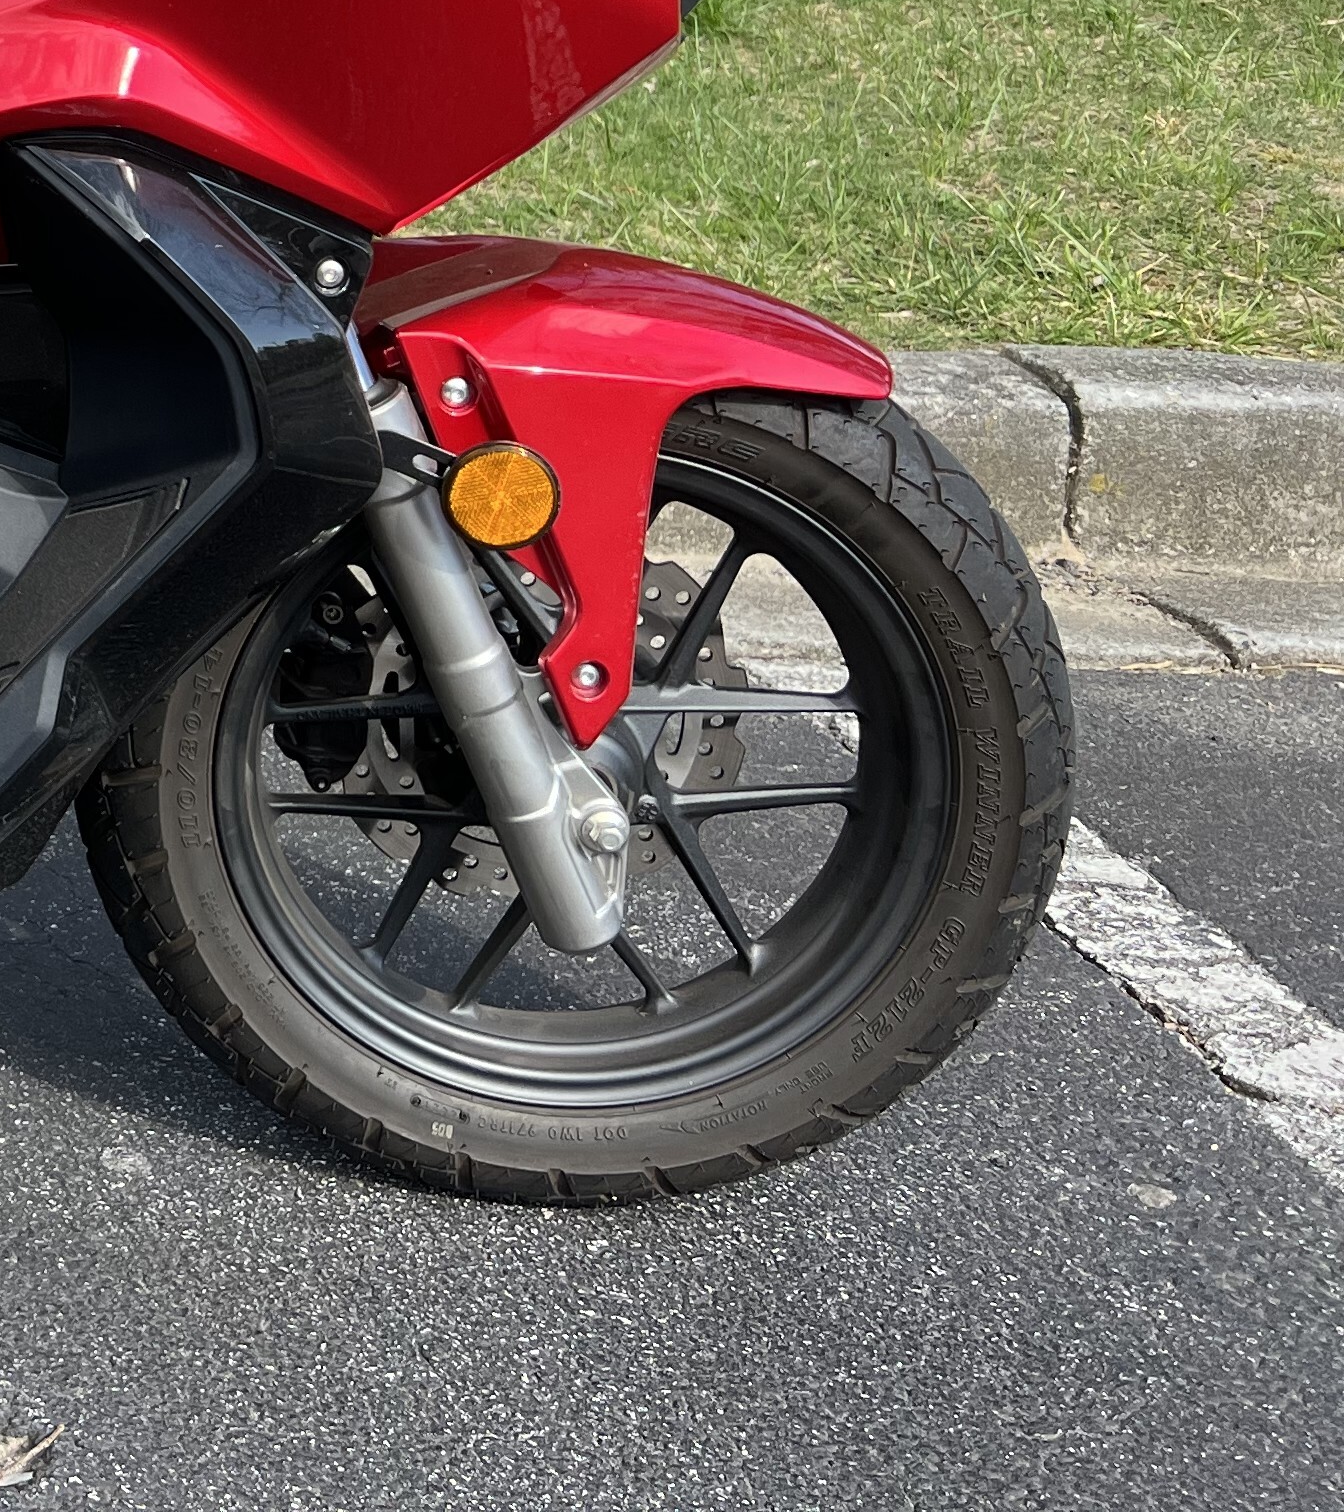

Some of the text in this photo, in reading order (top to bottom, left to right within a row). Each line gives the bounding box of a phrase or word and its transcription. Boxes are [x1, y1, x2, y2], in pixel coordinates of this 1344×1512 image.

[850, 587, 1003, 1063] TRAIL WINNER GP-212F
[699, 1100, 768, 1132] ROTATION
[593, 1125, 626, 1140] DOT
